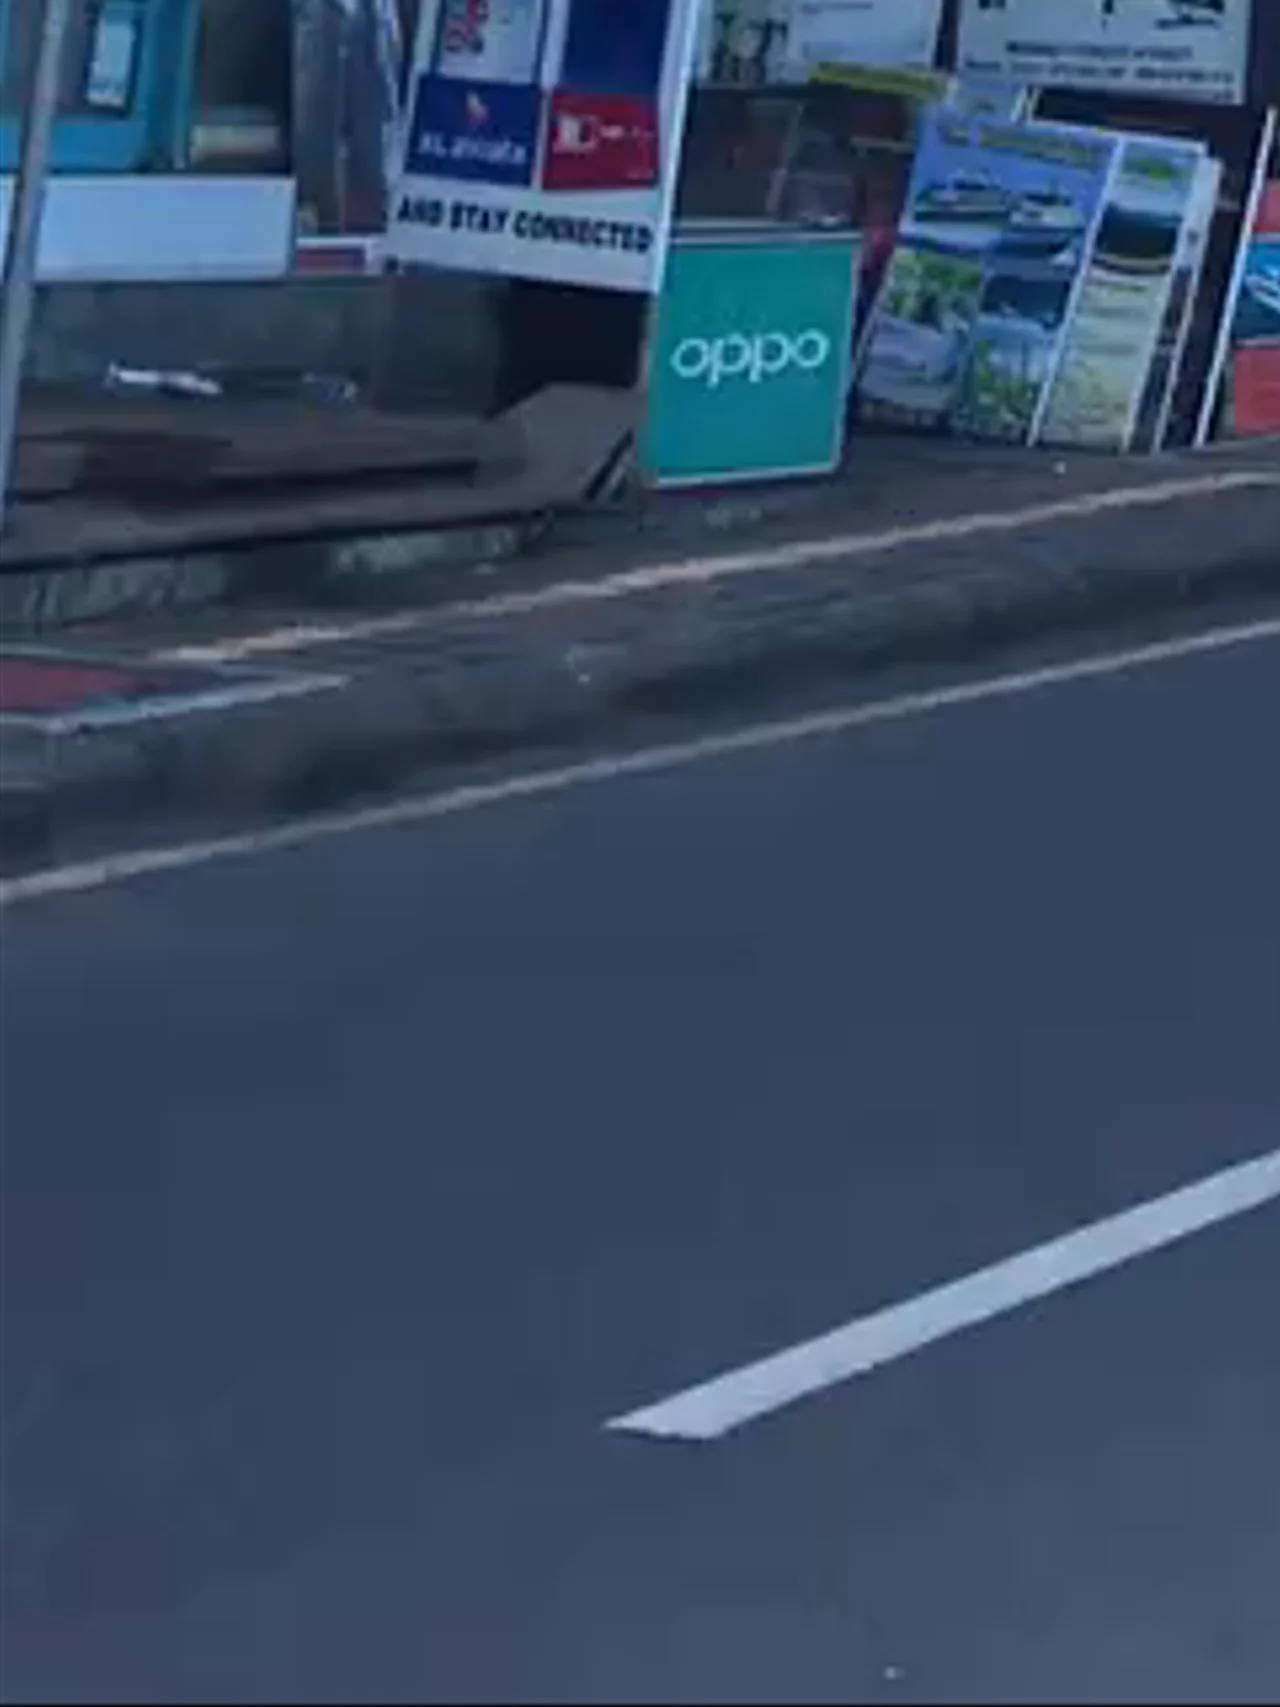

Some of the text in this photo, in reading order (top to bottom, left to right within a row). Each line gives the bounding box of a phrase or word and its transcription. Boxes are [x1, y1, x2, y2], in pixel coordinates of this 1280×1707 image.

[396, 196, 655, 254] AND STAY CONNECTED
[669, 328, 830, 388] oppo
